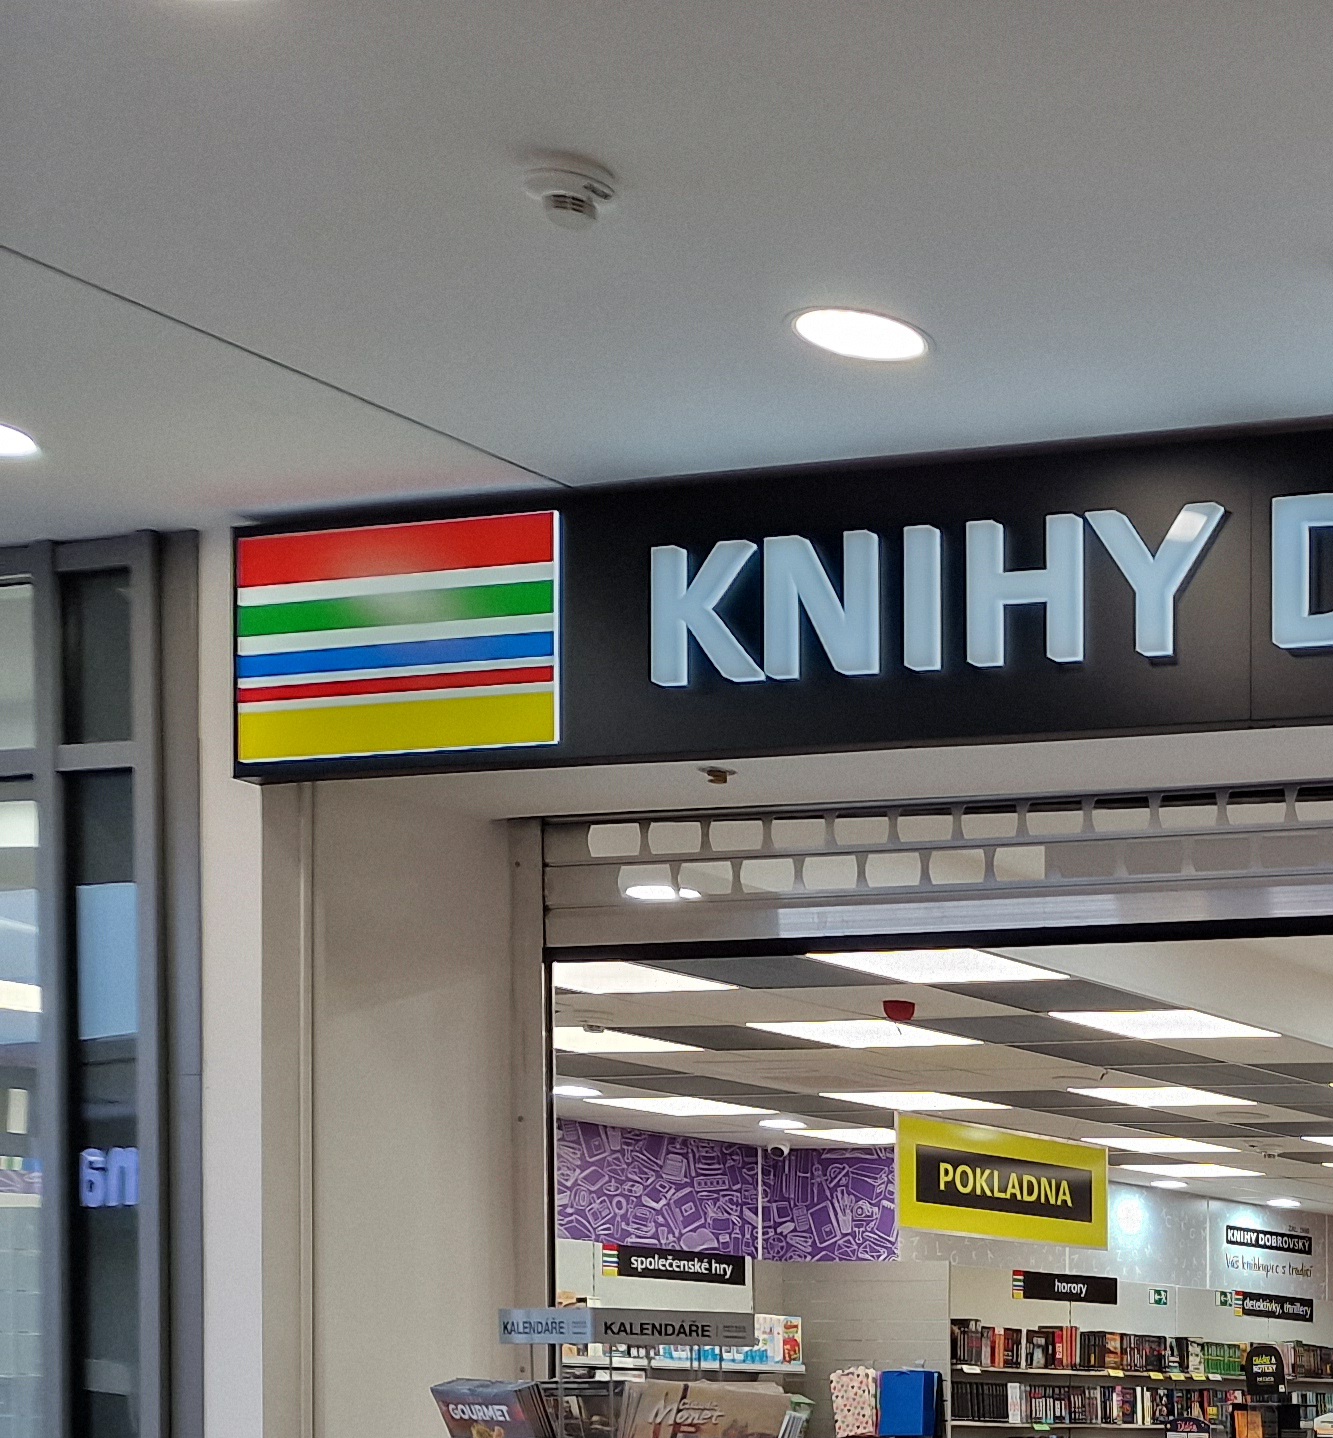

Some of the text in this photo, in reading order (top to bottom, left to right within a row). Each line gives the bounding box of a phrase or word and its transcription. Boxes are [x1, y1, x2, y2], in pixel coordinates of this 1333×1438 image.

[650, 502, 1227, 687] KNIHY
[939, 1161, 1072, 1208] POKLADNA
[1227, 1228, 1310, 1251] KNIHY DOBROVSKÝ
[630, 1253, 733, 1279] společenské hry
[1054, 1277, 1088, 1298] horory
[502, 1317, 565, 1336] KALENDÁŘE
[603, 1319, 711, 1338] KALENDÁŘE
[448, 1402, 511, 1423] GOURMET
